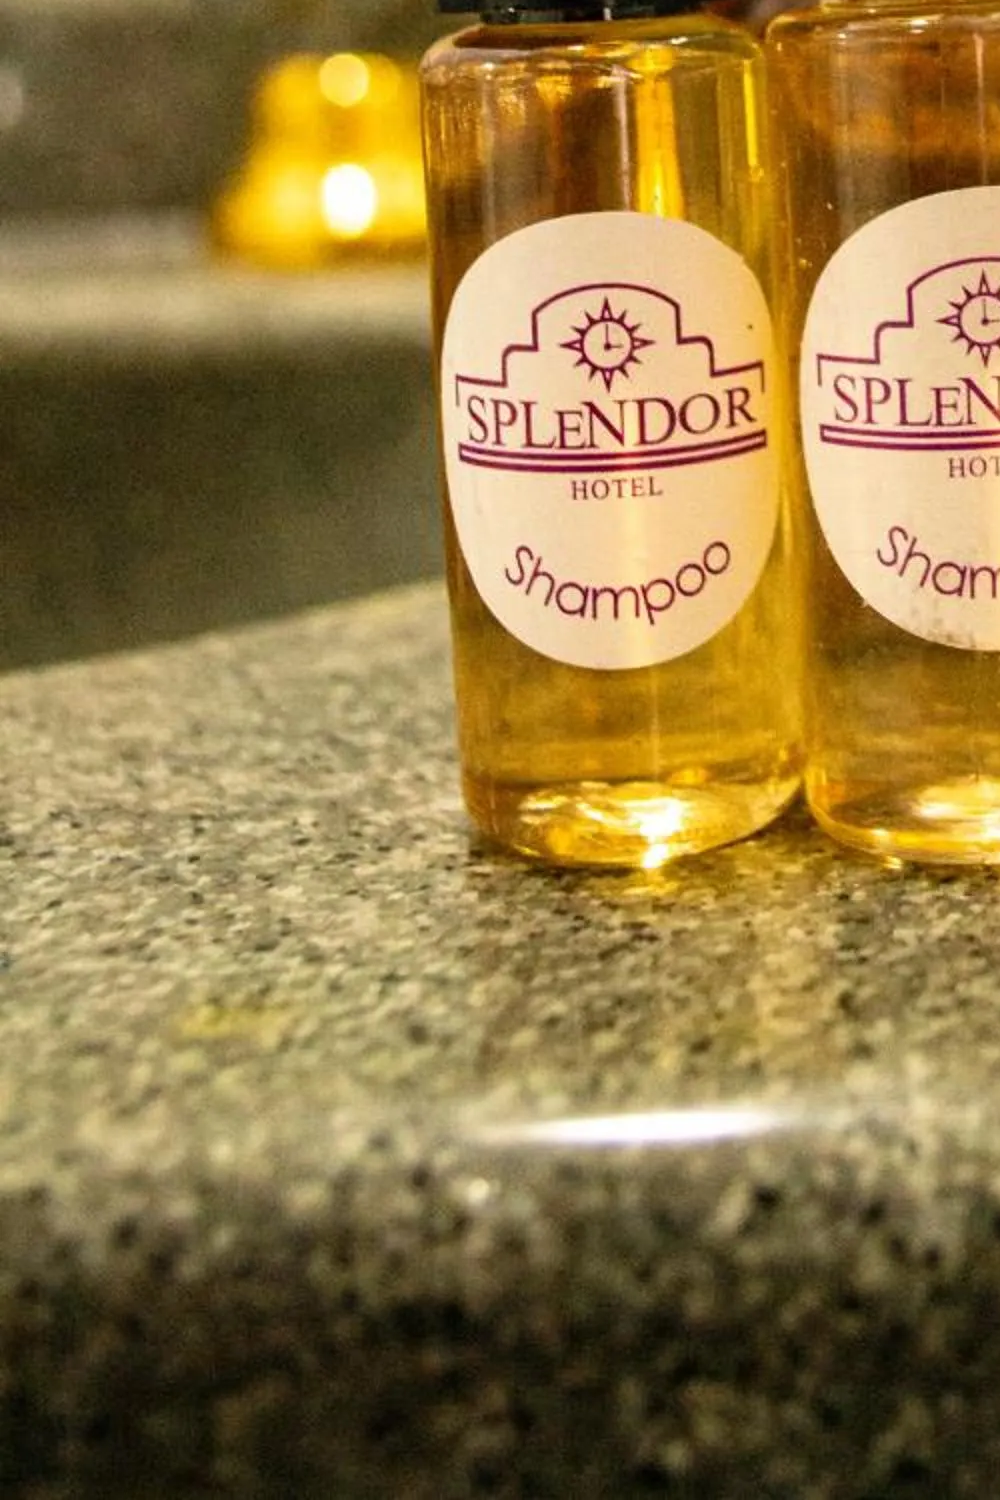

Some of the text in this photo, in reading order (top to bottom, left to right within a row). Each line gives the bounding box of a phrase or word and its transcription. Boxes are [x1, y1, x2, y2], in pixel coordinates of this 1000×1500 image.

[467, 387, 757, 449] SPLENDOR
[571, 476, 663, 501] HOTEL
[505, 541, 732, 626] Shampoo
